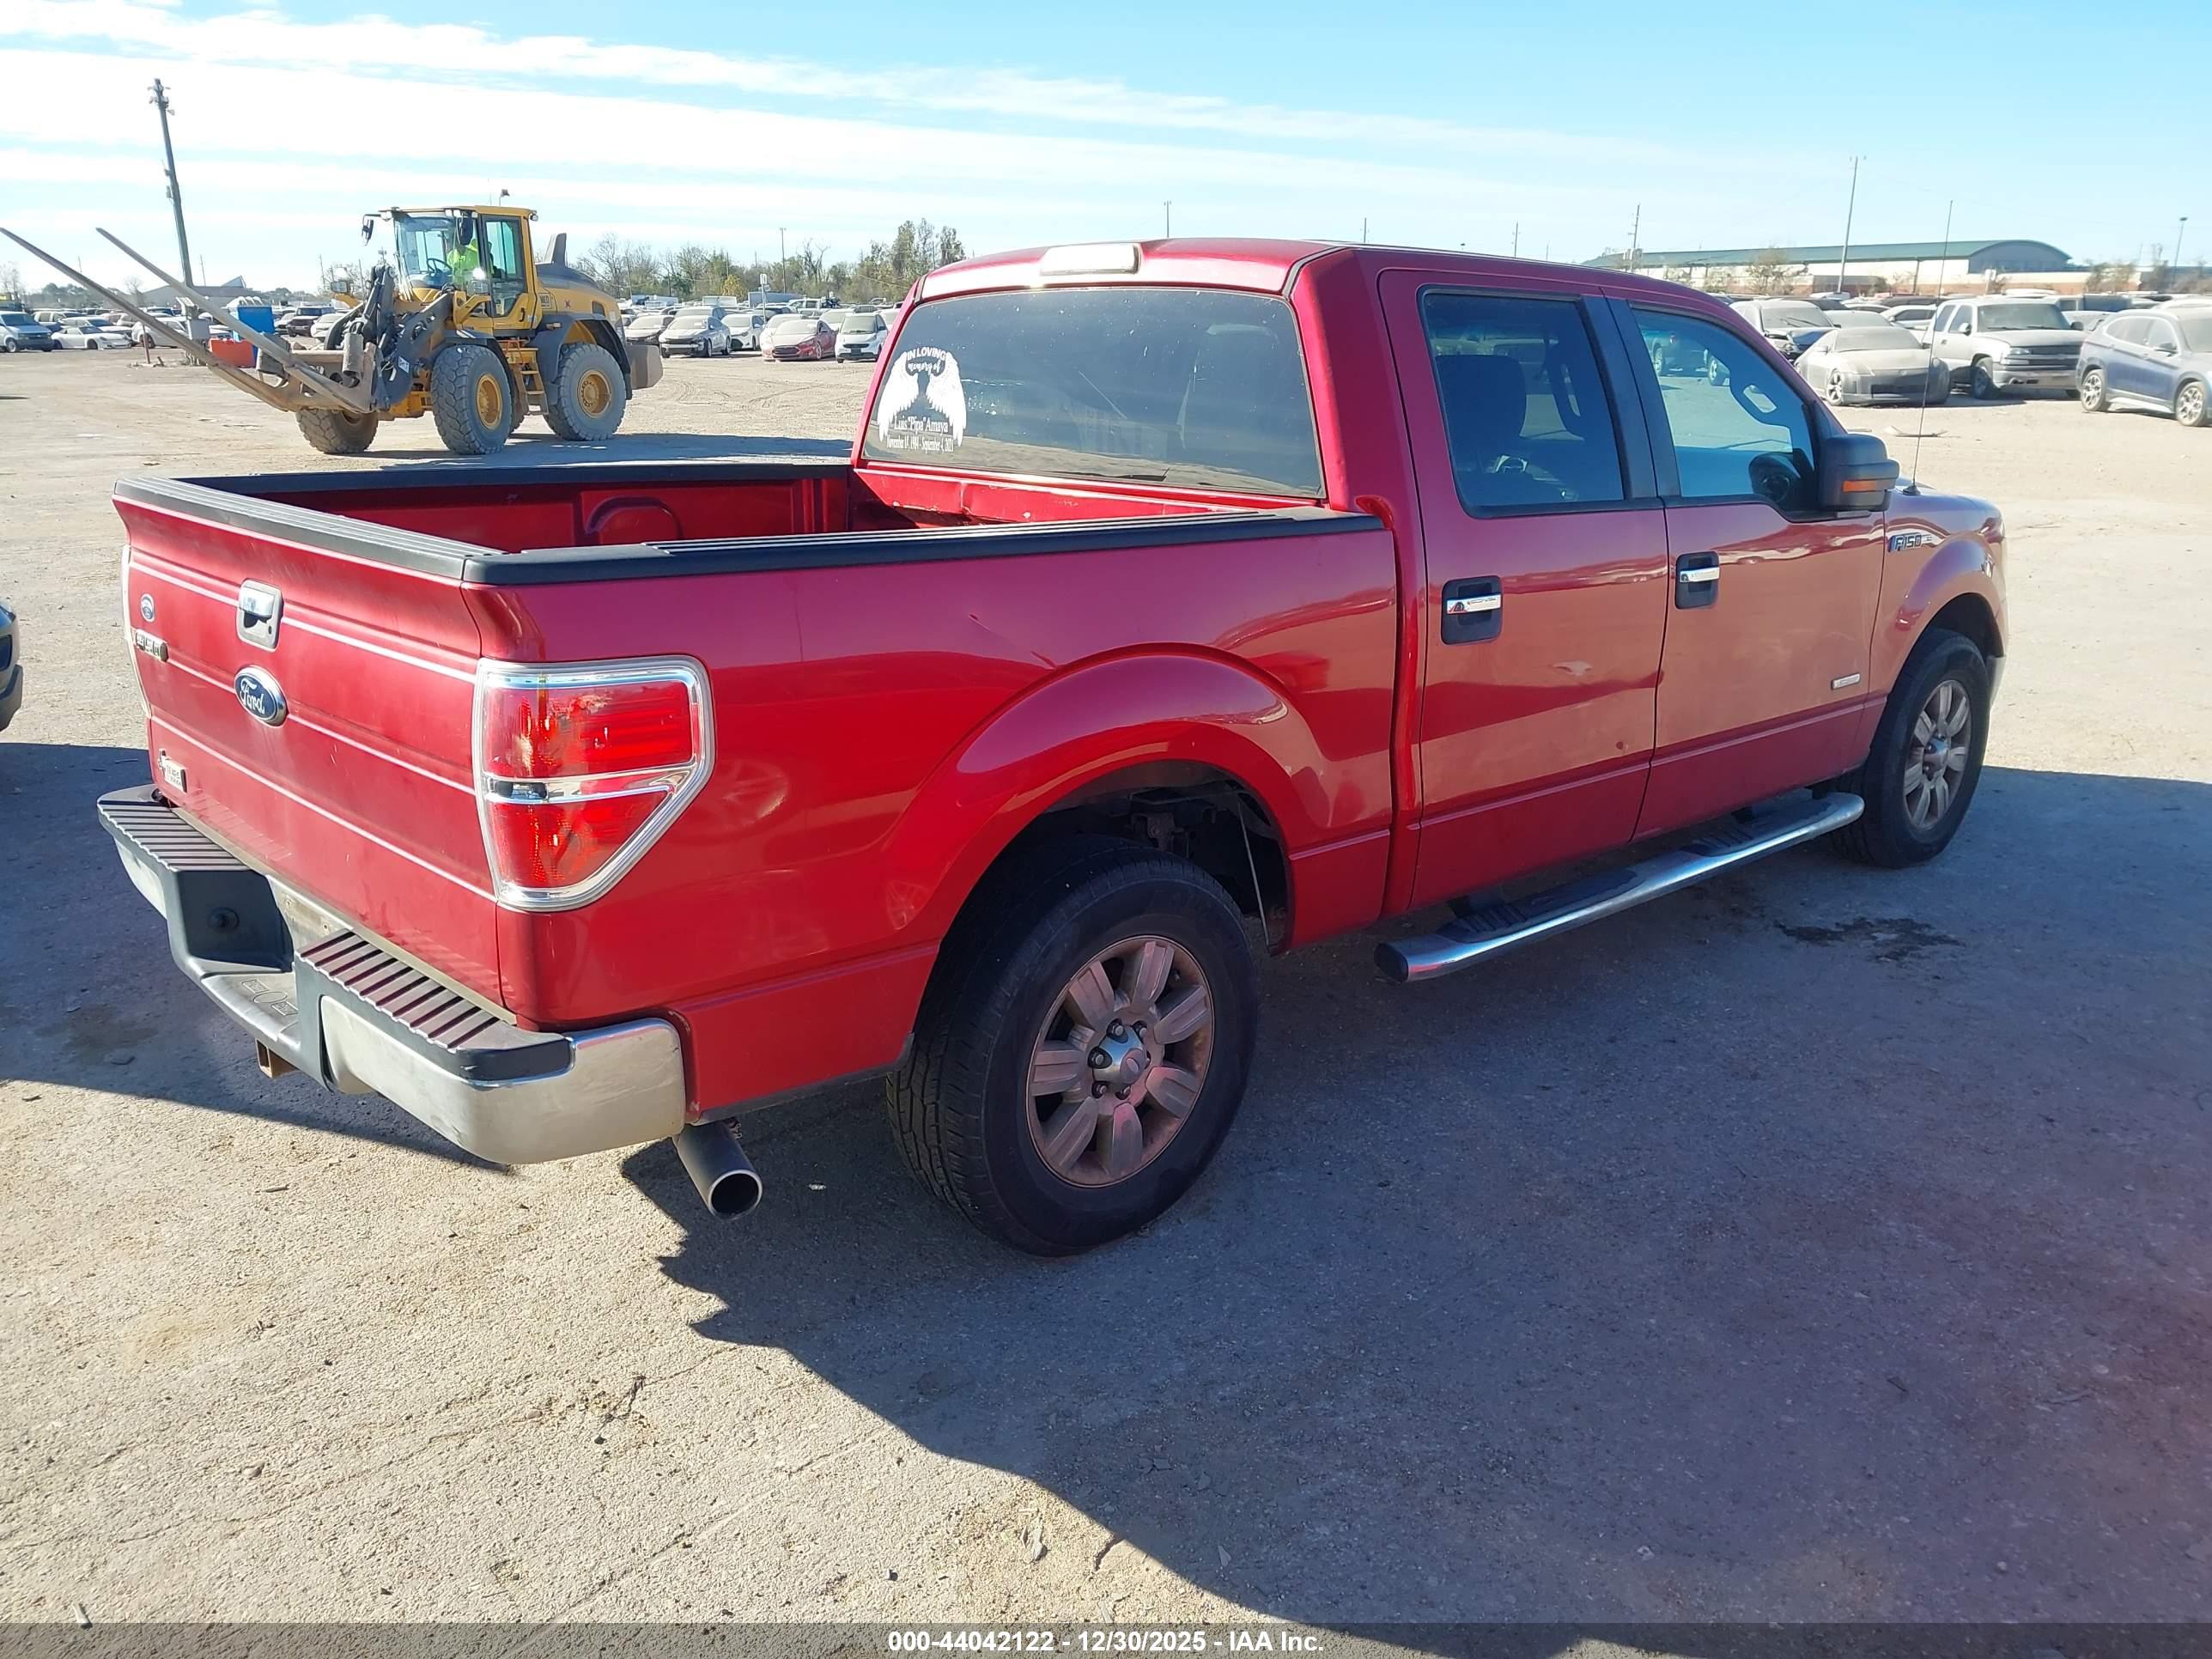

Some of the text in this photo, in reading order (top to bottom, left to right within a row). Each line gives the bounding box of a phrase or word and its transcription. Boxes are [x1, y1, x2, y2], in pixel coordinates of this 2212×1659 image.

[907, 346, 946, 361] IN LOVING
[908, 359, 941, 375] memory of
[894, 415, 908, 430] Luis
[925, 416, 949, 436] Amaya
[240, 678, 265, 714] Ford
